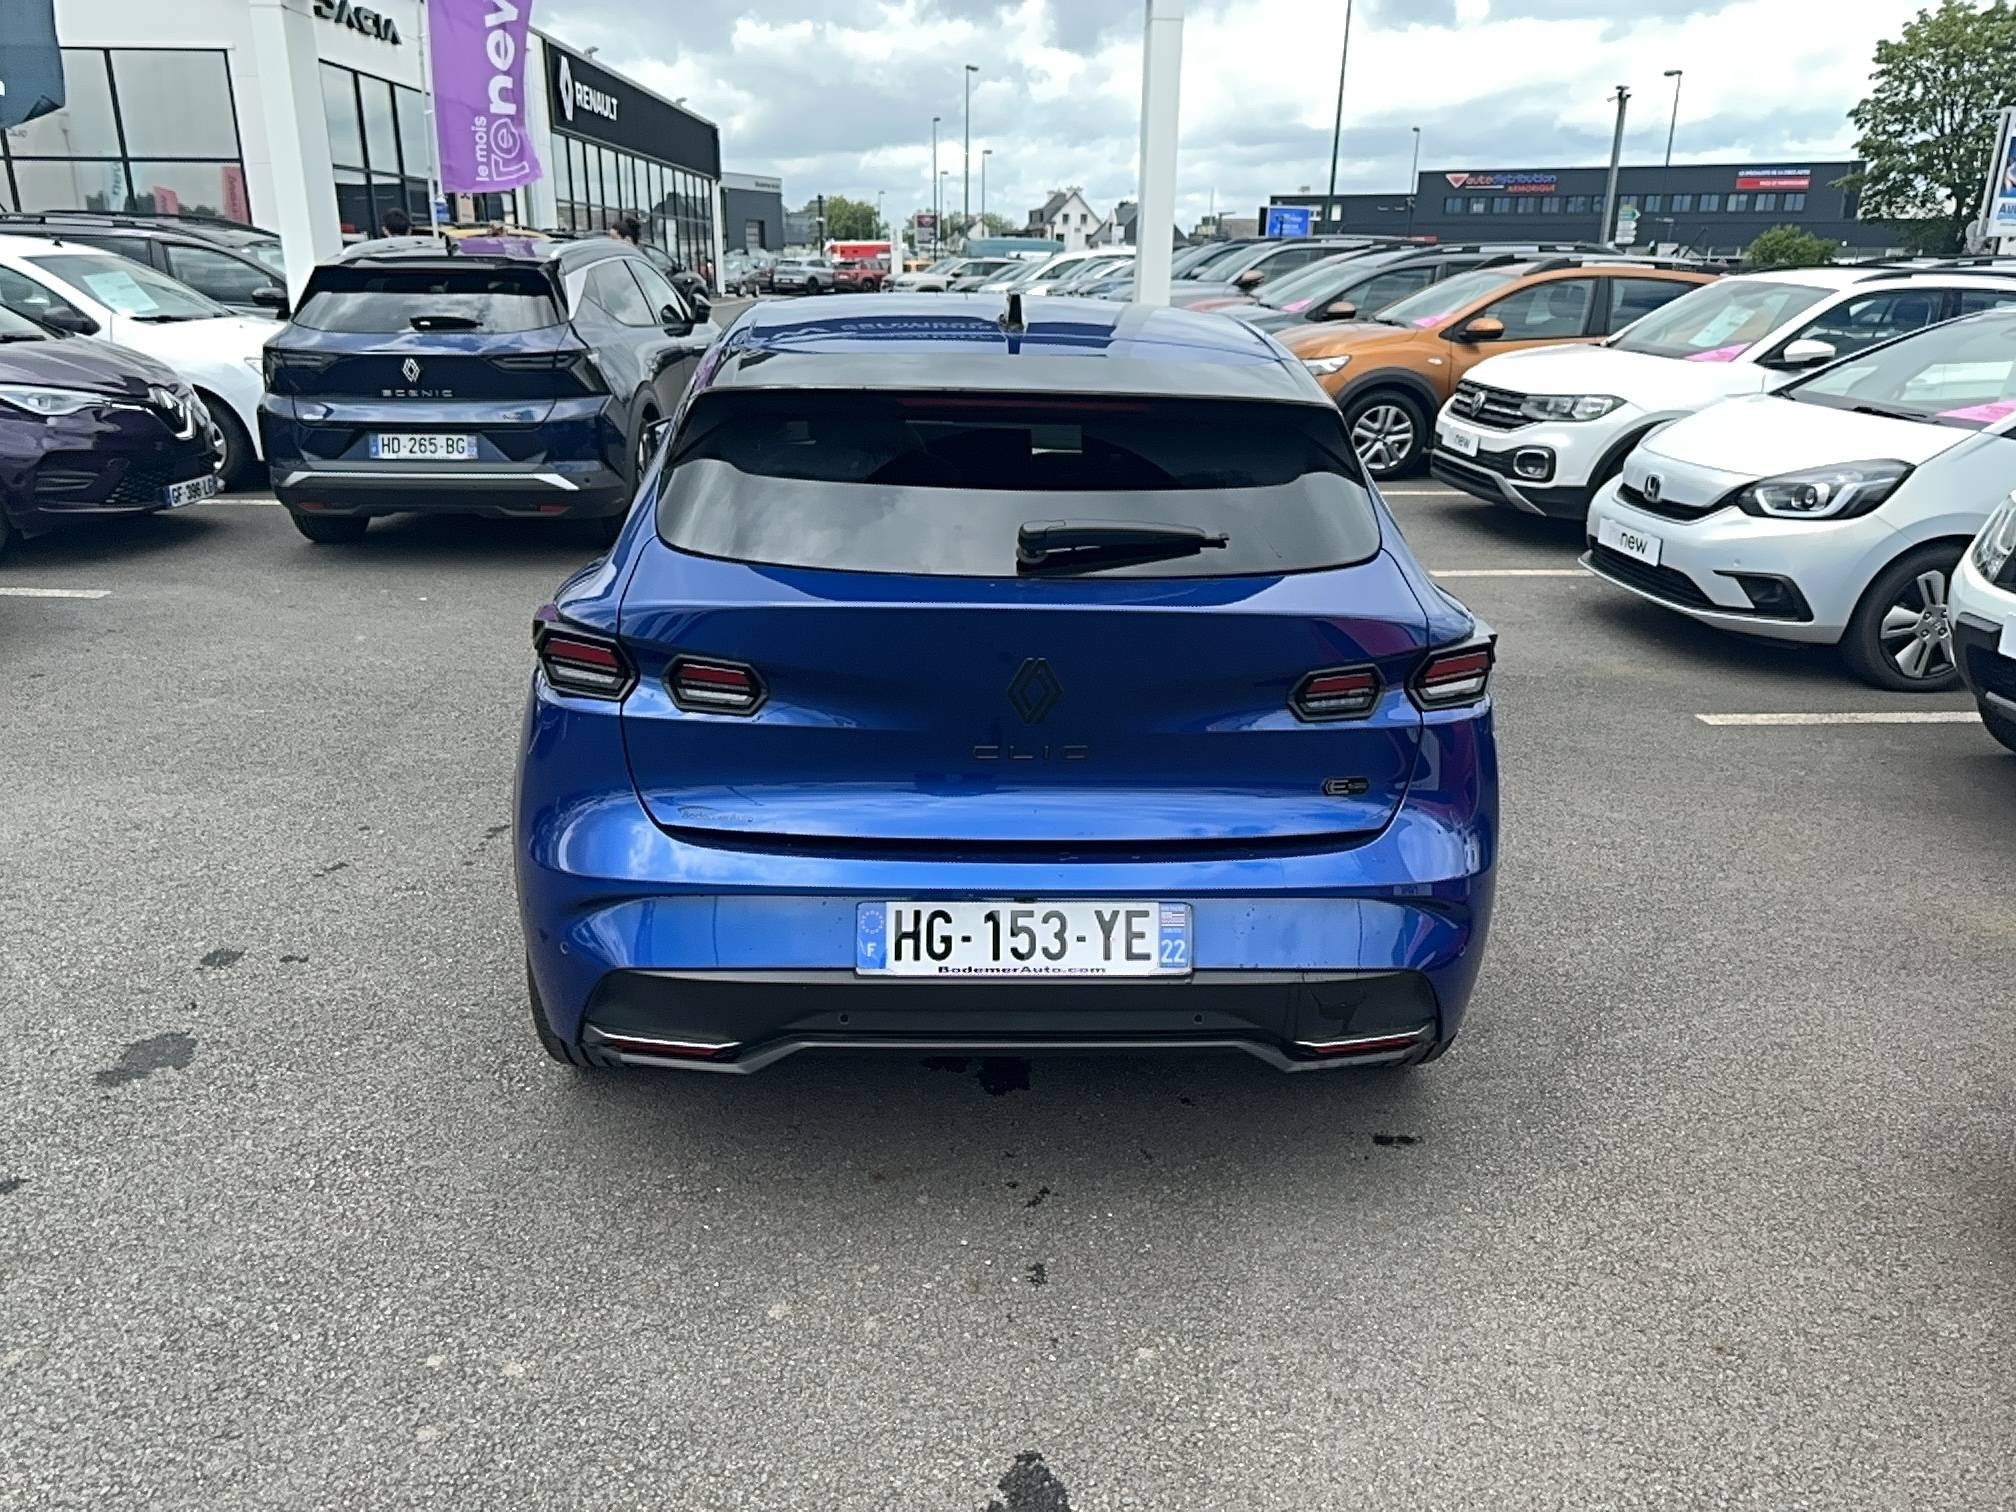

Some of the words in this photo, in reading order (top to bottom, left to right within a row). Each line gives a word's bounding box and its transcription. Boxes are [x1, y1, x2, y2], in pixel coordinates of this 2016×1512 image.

[314, 0, 402, 45] DACIA
[575, 81, 618, 121] RENAULT
[472, 116, 488, 163] mois
[476, 165, 490, 182] le
[381, 437, 465, 455] HD-265-BG
[1620, 532, 1648, 555] new
[894, 909, 1153, 962] HG-153-YE
[867, 942, 877, 958] F
[1161, 939, 1185, 963] 22
[938, 965, 1106, 974] BodemerAuto.com
